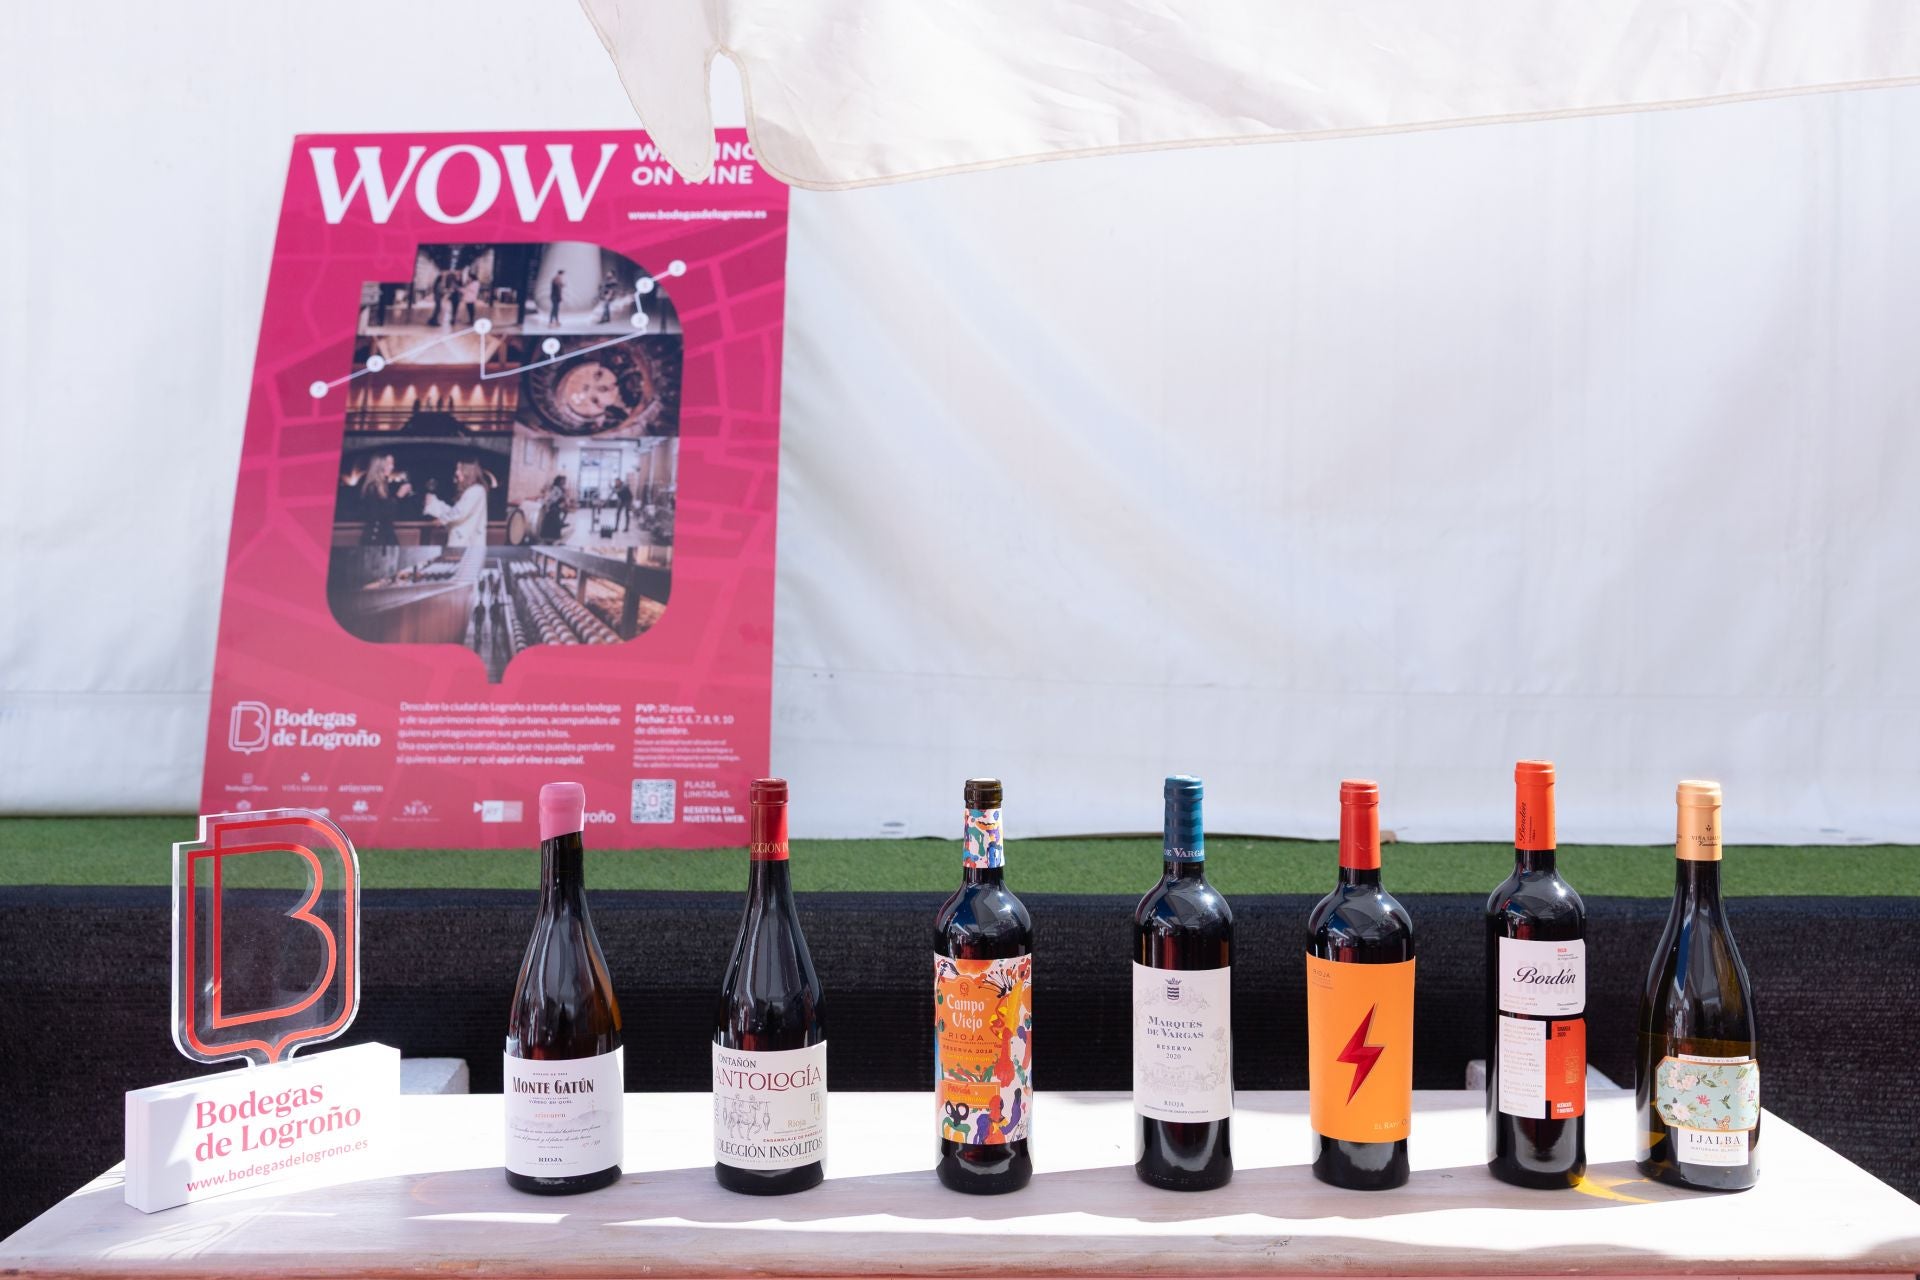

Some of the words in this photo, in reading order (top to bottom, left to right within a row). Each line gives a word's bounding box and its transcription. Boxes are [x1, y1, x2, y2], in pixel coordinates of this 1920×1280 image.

[634, 141, 758, 162] WING
[308, 143, 619, 224] WOW
[632, 166, 674, 186] ON
[683, 165, 755, 185] INE
[274, 708, 357, 731] Bodegas
[271, 728, 297, 746] de
[300, 729, 382, 750] Logroño
[683, 781, 716, 790] PLAZAS
[683, 806, 722, 815] RESERVA
[1512, 966, 1577, 985] Bordón
[946, 993, 985, 1015] Campo
[952, 1012, 983, 1032] Viejo
[948, 1032, 984, 1042] RIOJA
[1156, 1043, 1192, 1051] RESERVA
[1166, 1052, 1182, 1060] 2020
[714, 1063, 822, 1092] ANTOLOGÍA
[196, 1083, 324, 1130] Bodegas
[1164, 1100, 1184, 1108] RIOJA
[195, 1133, 232, 1162] de
[241, 1105, 361, 1152] Logroño
[1689, 1133, 1742, 1146] IJALBA
[769, 1136, 823, 1159] INSÓLITOS
[187, 1137, 369, 1193] www.bodegasdelogrono.es
